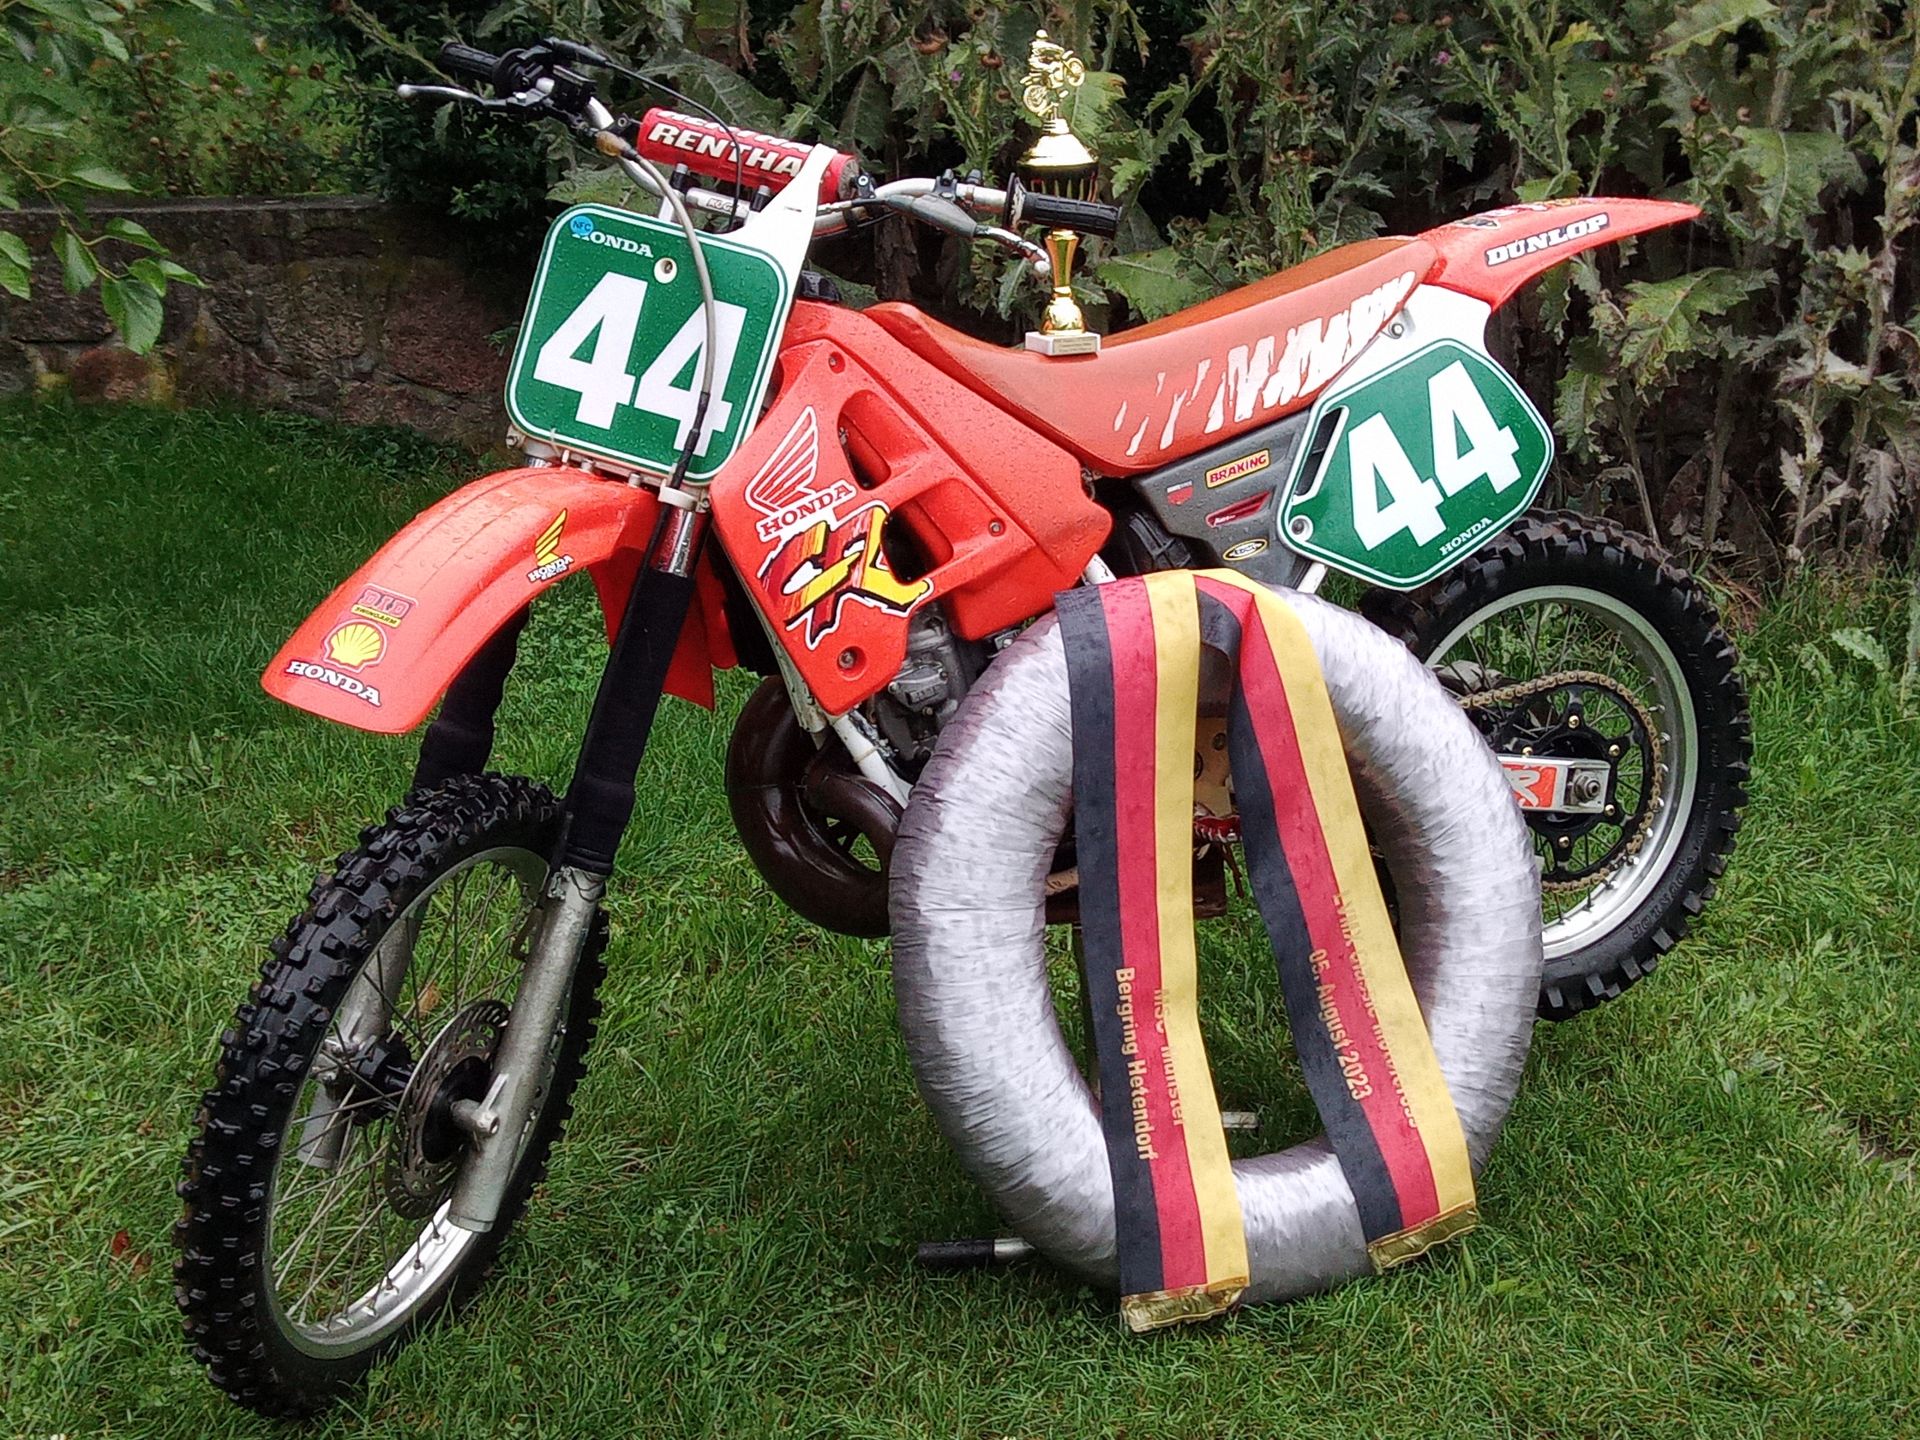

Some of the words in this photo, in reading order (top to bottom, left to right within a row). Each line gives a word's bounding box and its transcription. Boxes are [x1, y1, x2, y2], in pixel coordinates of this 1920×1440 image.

[648, 122, 804, 178] RENTHA
[572, 220, 592, 231] NFC
[572, 231, 654, 258] ONDA
[1487, 213, 1609, 266] DUNLOP
[533, 271, 747, 457] 44
[1209, 454, 1267, 483] BRAKING
[1347, 360, 1521, 552] 44
[760, 484, 851, 537] HONDA
[1439, 517, 1493, 557] HONDA
[526, 554, 575, 583] HONDA
[286, 659, 382, 707] HONDA
[1307, 947, 1330, 981] 05.
[1115, 967, 1140, 1056] Bergring
[1315, 982, 1353, 1050] August
[1336, 1049, 1373, 1102] 2023
[1127, 1058, 1159, 1161] Hetendorf
